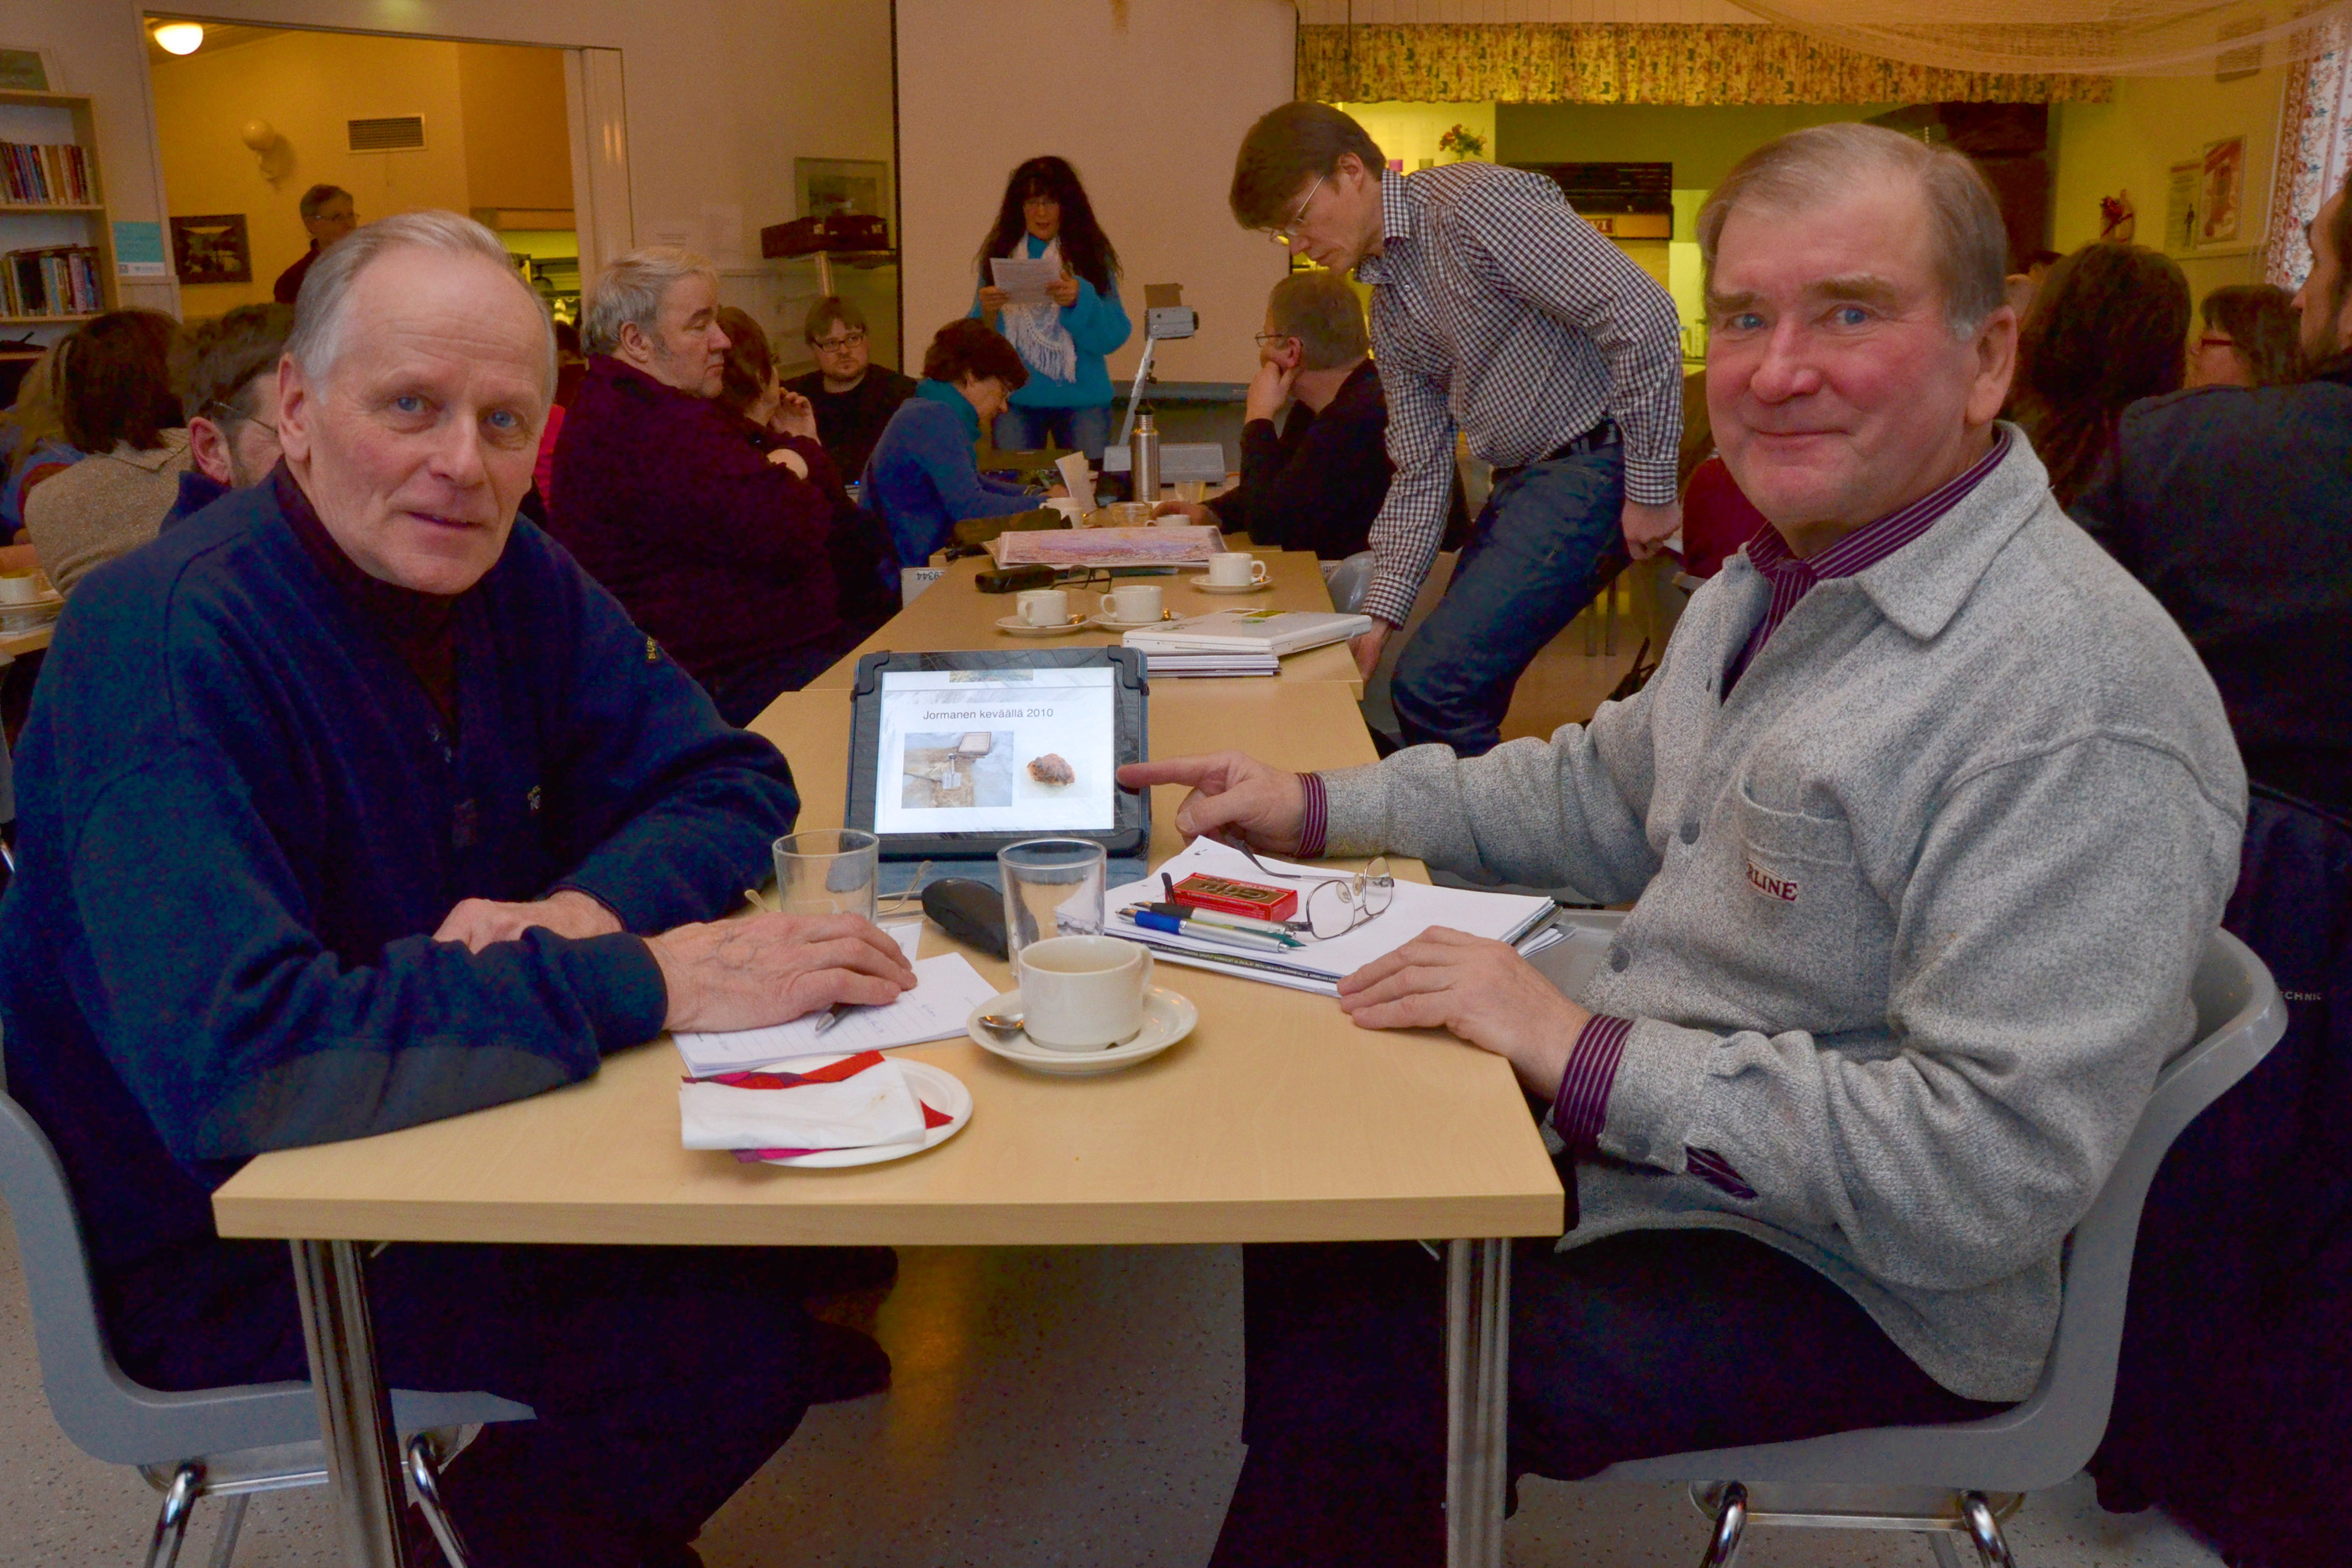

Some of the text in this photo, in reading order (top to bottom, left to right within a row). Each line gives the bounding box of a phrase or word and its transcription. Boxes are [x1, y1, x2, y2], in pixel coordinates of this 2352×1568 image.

[922, 708, 1053, 720] Jormanen keväällä 2010
